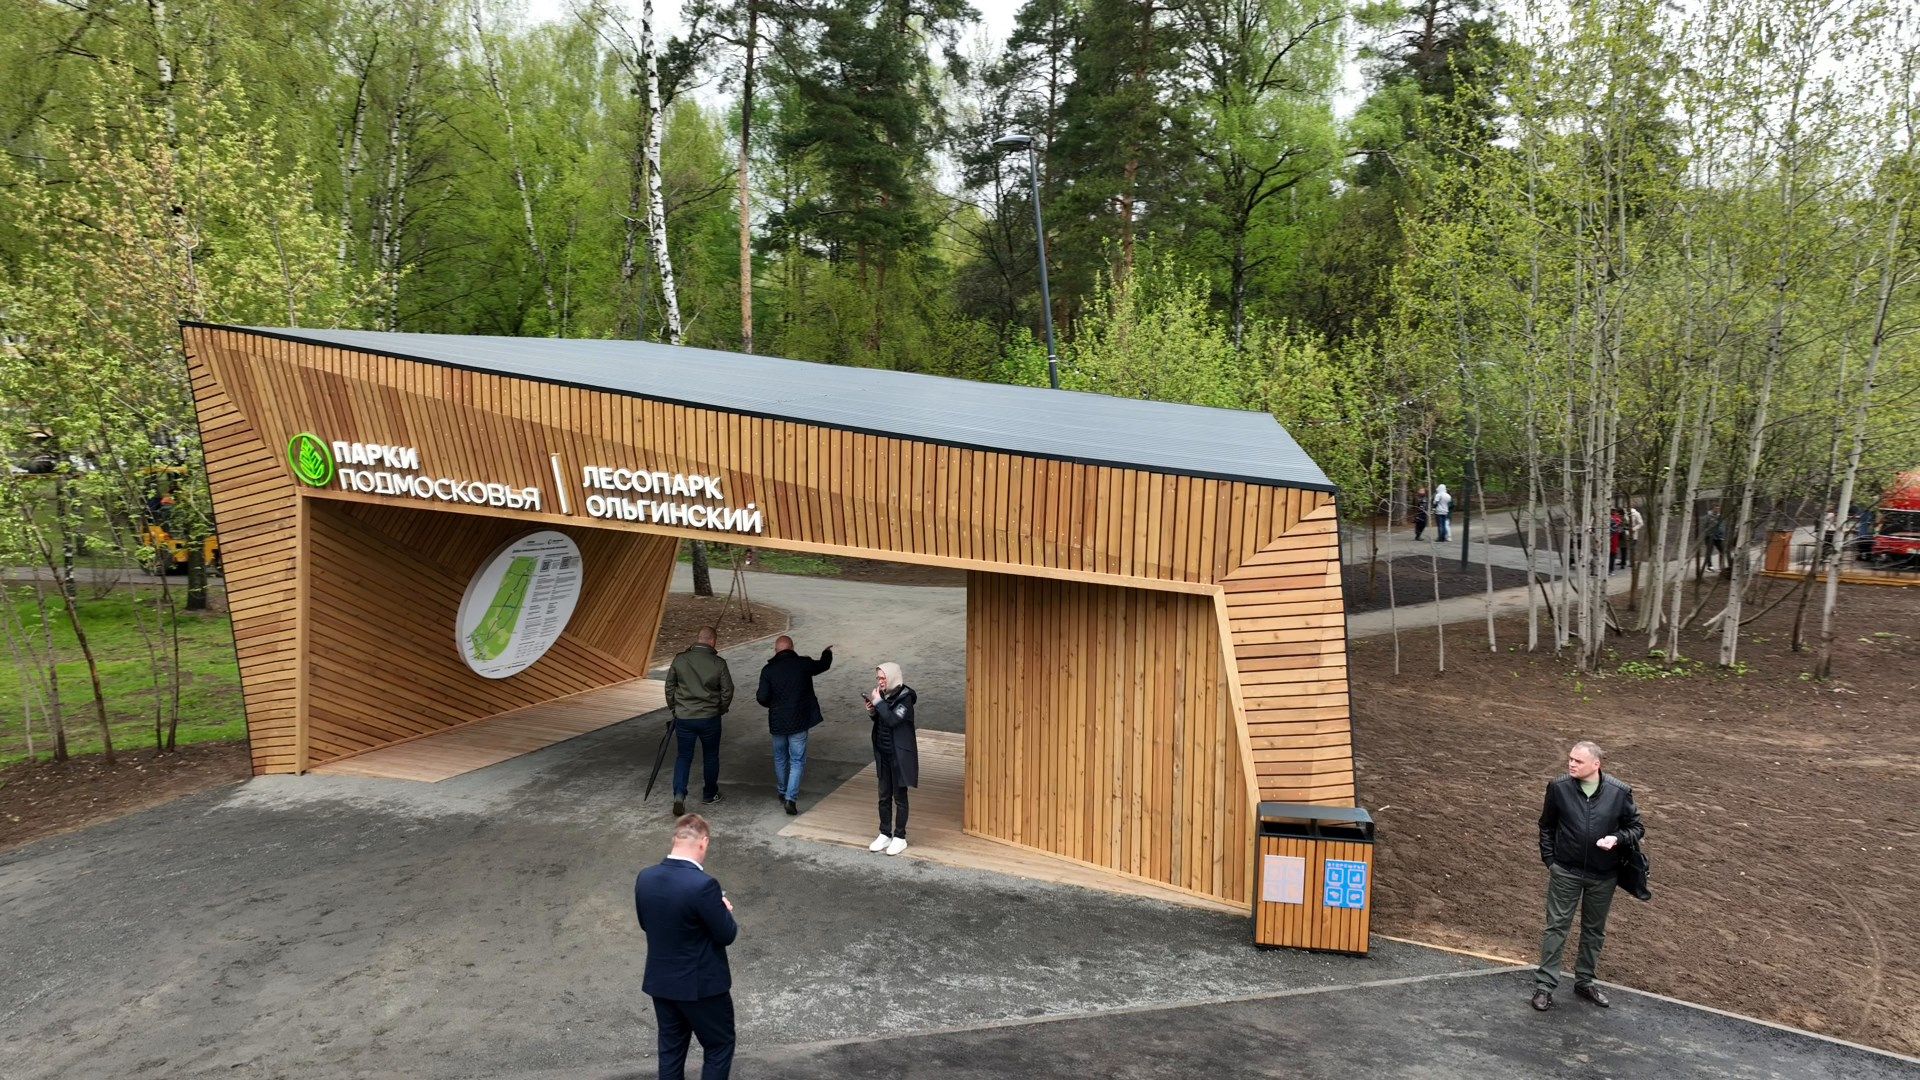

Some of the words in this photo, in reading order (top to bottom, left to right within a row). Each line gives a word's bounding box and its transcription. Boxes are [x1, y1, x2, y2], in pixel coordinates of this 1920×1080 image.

[333, 441, 419, 470] ПАРКИ
[339, 468, 541, 511] ПОДМОСКОВЬЯ
[583, 466, 724, 500] ЛЕСОПАРК
[586, 495, 762, 534] ОЛЬГИНСКИЙ
